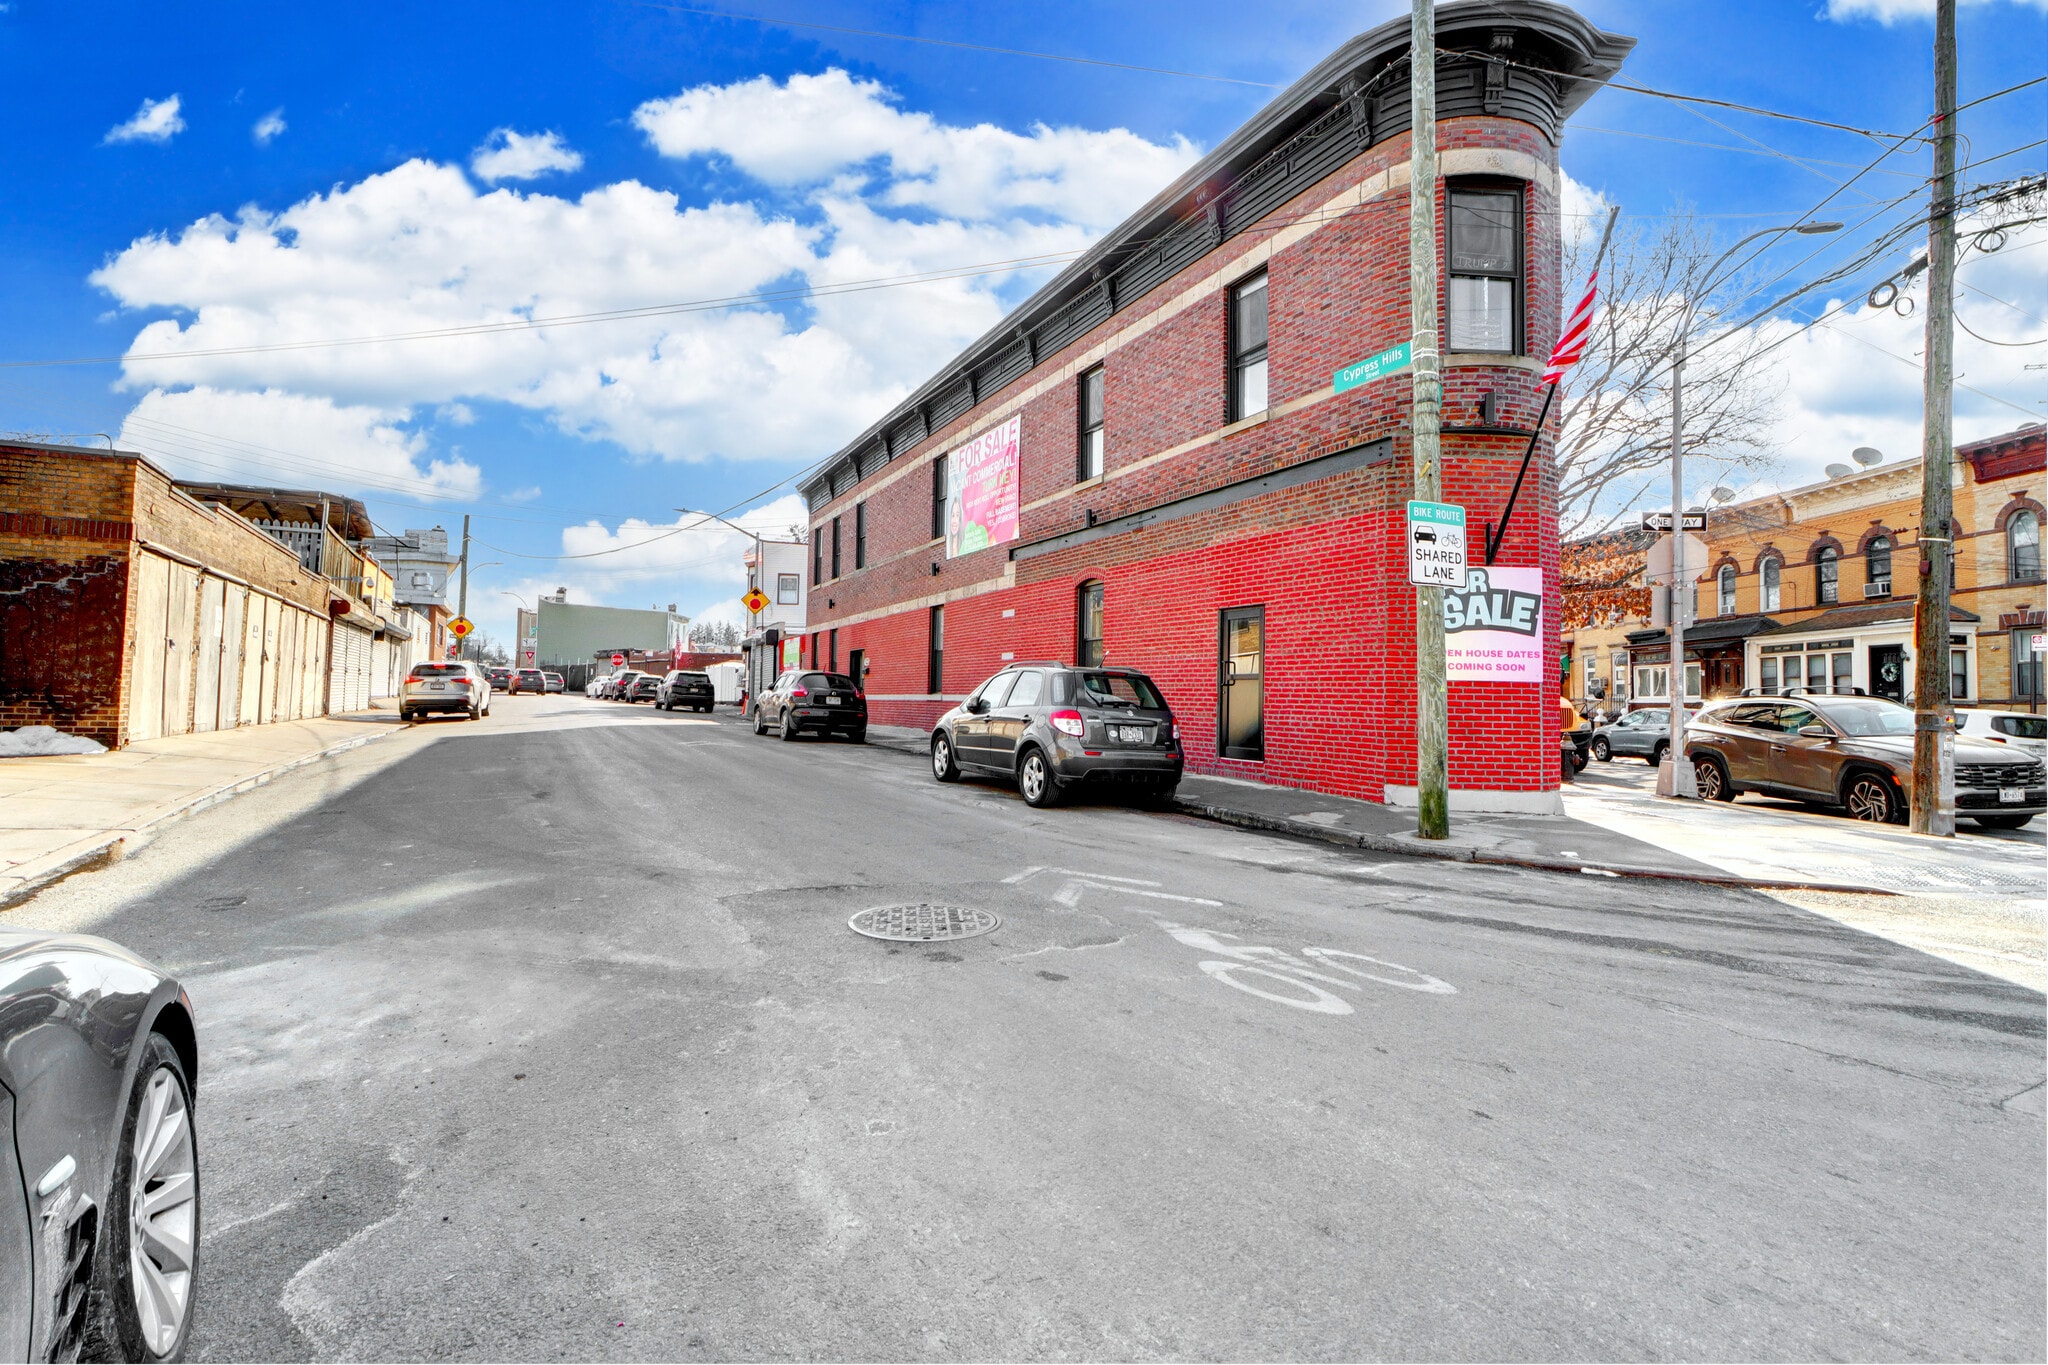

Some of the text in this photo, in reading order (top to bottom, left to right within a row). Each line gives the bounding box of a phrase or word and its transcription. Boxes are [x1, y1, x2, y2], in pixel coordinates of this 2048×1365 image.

[1456, 256, 1496, 269] TRUMP
[1344, 349, 1403, 381] Cypress Hills
[1365, 369, 1380, 379] Street
[959, 440, 981, 472] FOR
[985, 420, 1017, 458] SALE
[1414, 507, 1460, 521] BIKE ROUTE
[1651, 518, 1697, 526] ONE AY
[1416, 549, 1462, 564] SHARED
[1424, 565, 1454, 580] LANE
[1444, 594, 1536, 631] SALE
[1466, 650, 1503, 658] HOUSE
[1507, 651, 1540, 659] DATES
[1448, 663, 1526, 671] COMING SOON
